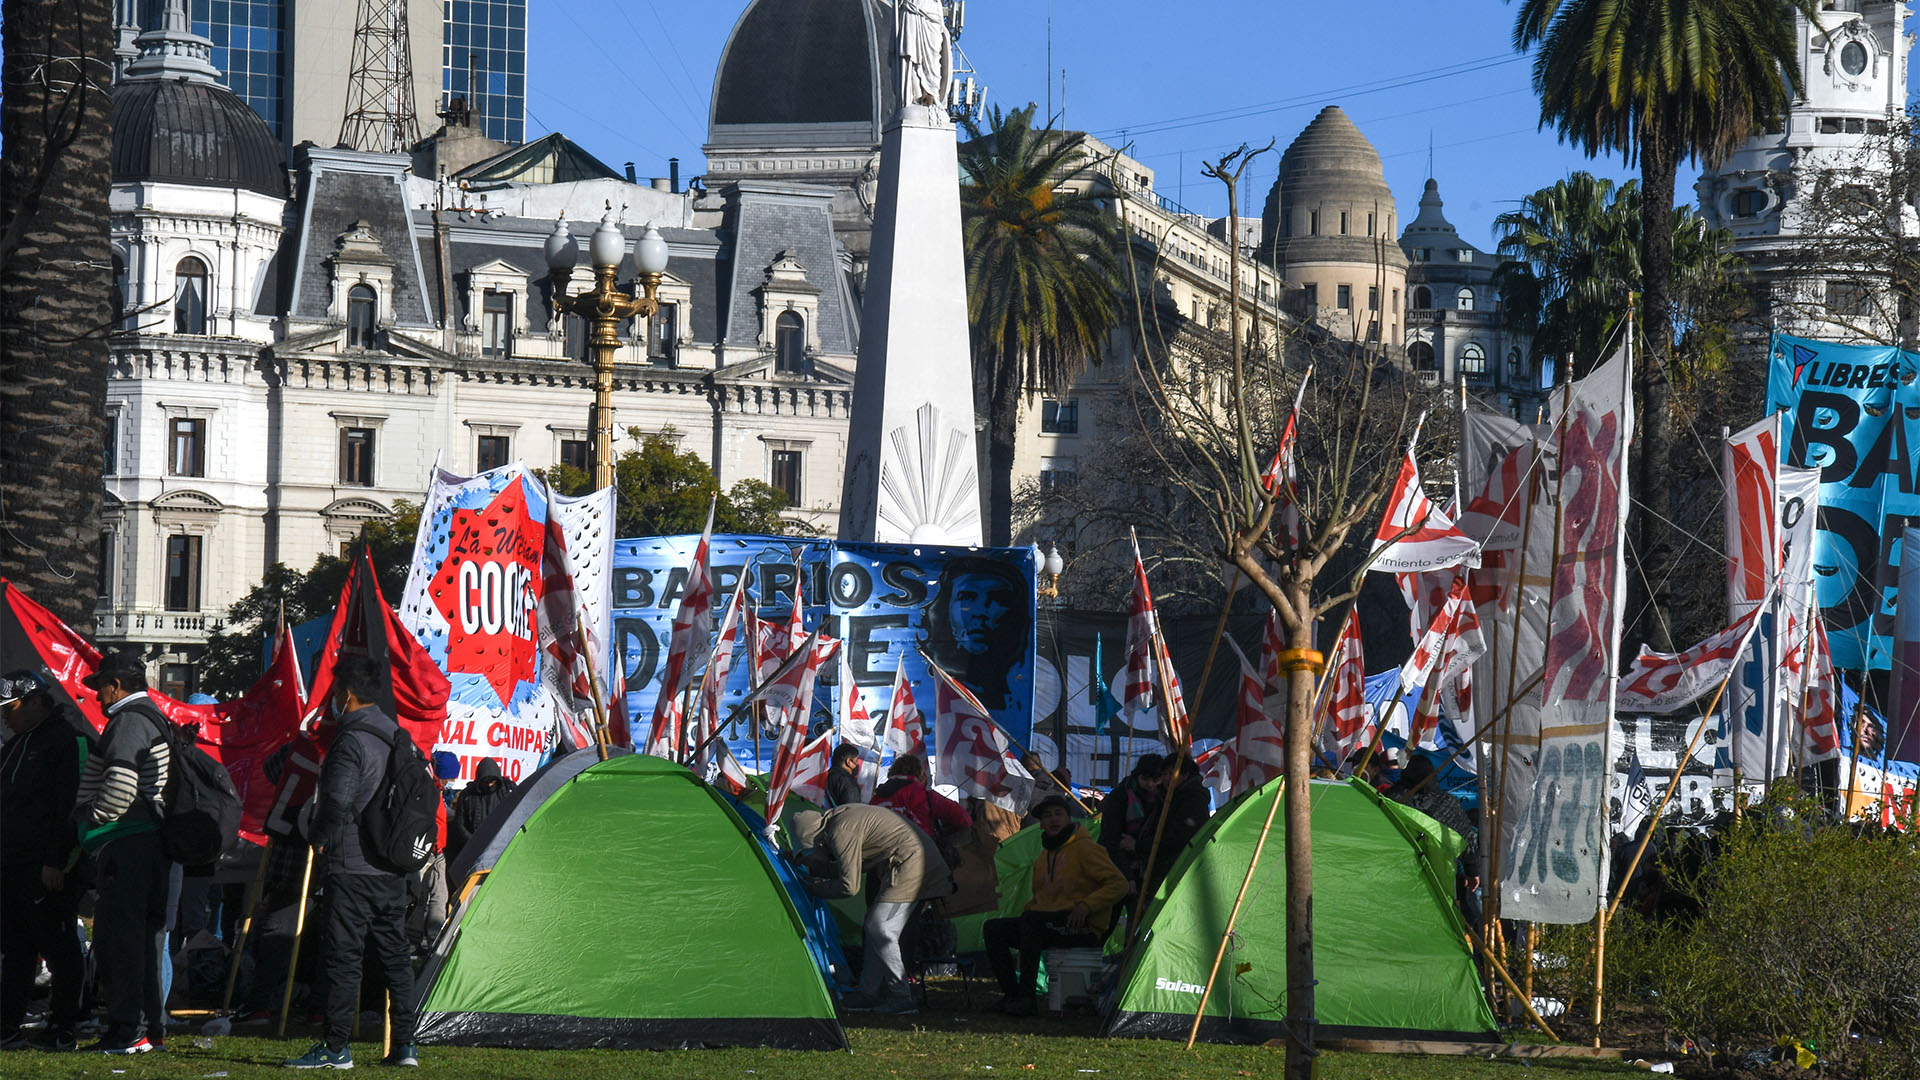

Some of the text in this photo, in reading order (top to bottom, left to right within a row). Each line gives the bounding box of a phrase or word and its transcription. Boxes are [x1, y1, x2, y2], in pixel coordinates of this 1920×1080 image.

[1807, 362, 1900, 390] LIBRES
[1788, 390, 1920, 494] BA
[454, 526, 481, 555] La
[1375, 555, 1431, 568] vimiento
[611, 561, 928, 609] BARRIOS
[436, 720, 477, 745] NAL
[487, 722, 549, 754] CAMPA
